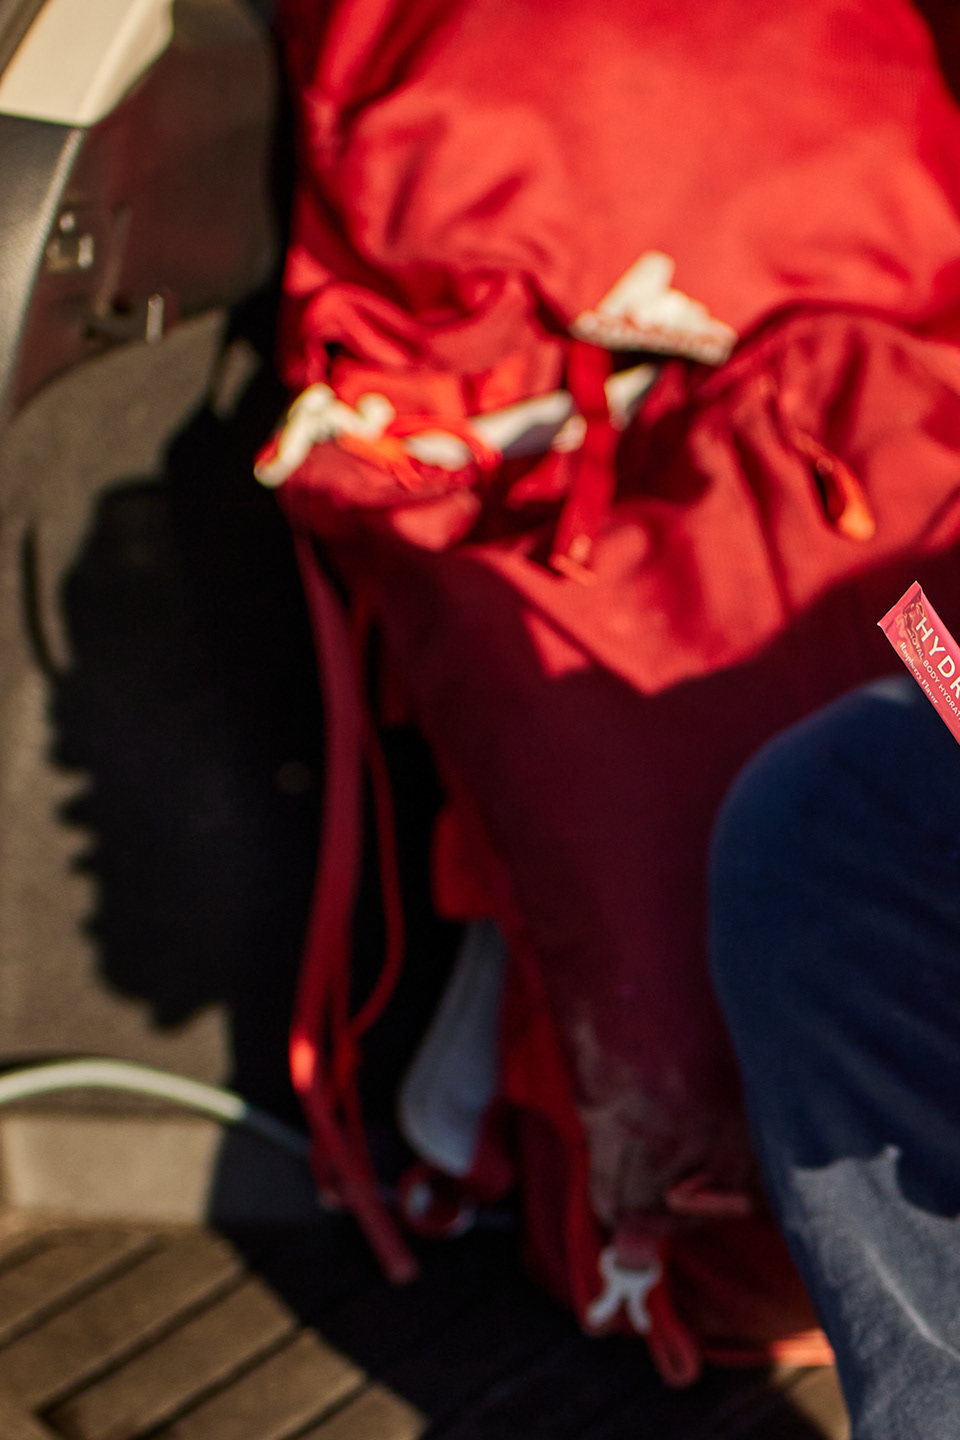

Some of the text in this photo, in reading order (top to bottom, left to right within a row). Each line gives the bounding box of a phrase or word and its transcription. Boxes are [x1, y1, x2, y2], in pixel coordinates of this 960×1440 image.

[899, 641, 939, 705] Raspberry Flavor
[909, 632, 926, 660] TOTAL
[922, 659, 940, 683] BODY
